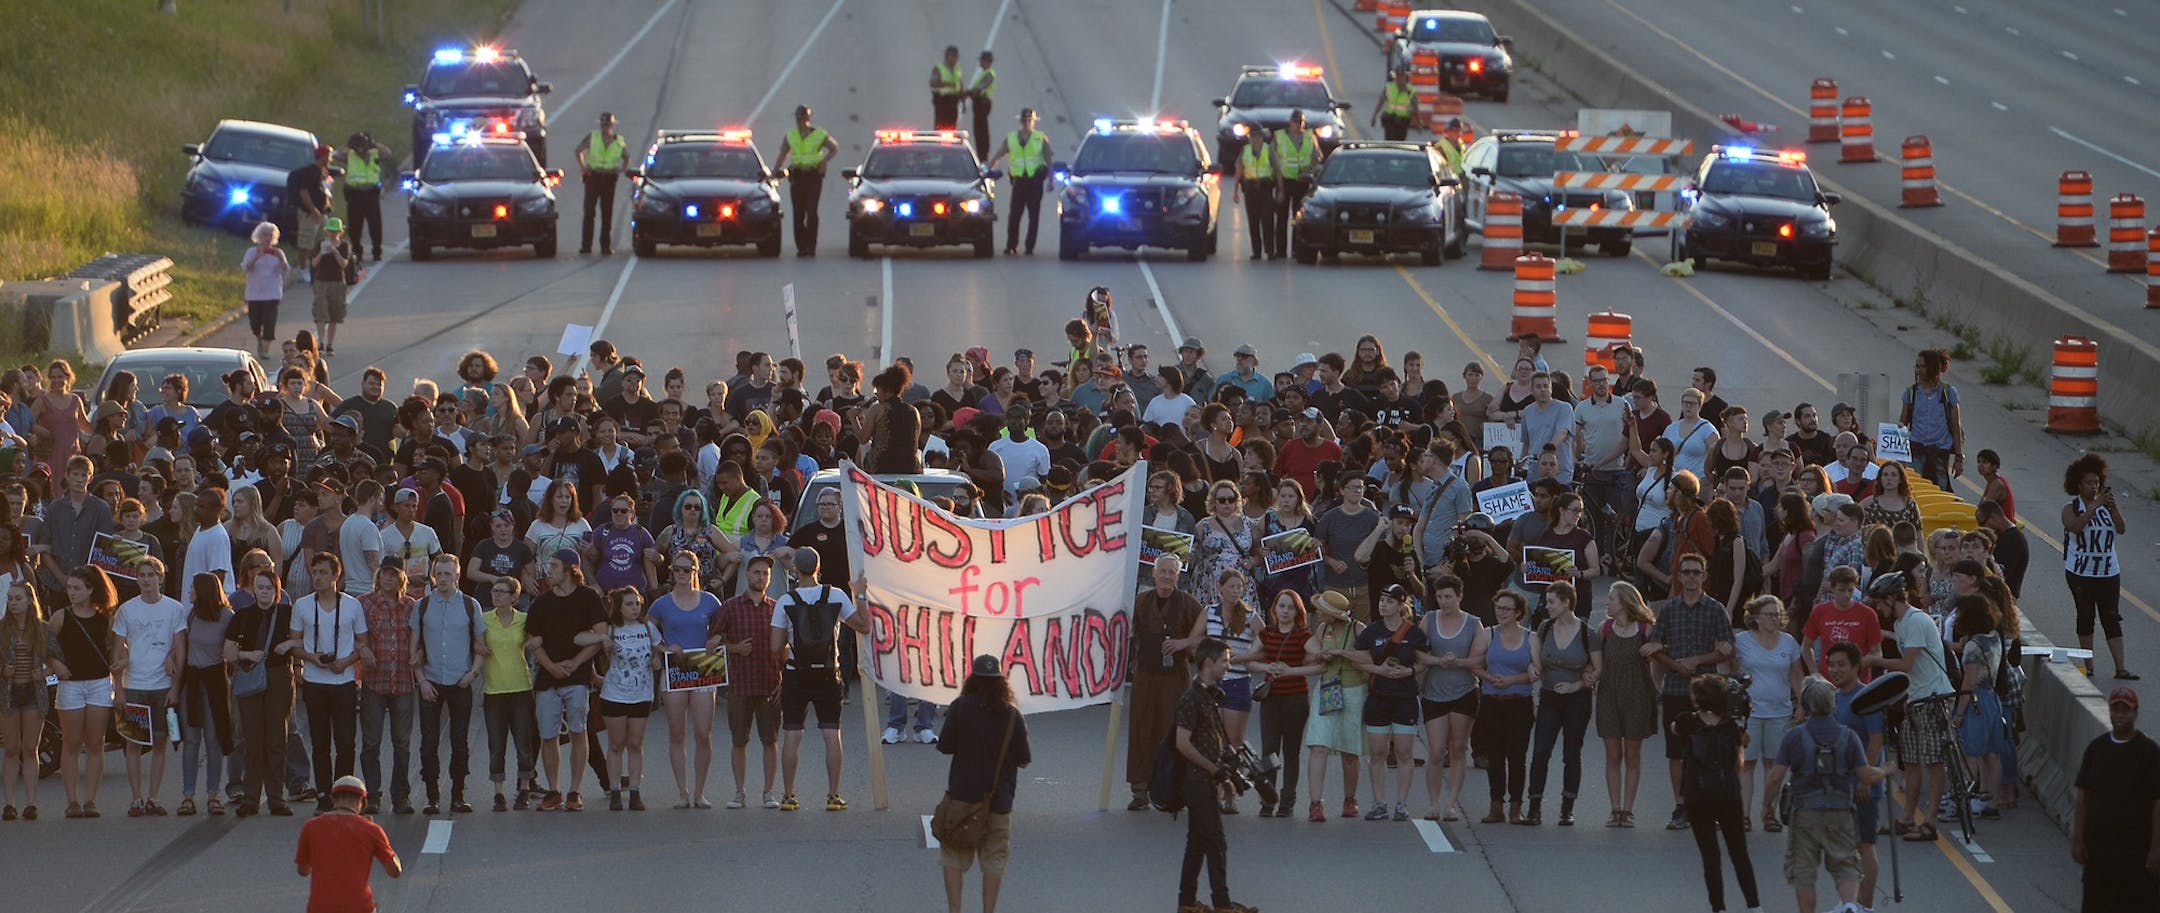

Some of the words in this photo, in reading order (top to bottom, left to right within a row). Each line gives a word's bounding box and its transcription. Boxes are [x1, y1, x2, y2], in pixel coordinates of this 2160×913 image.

[1483, 493, 1528, 516] SHAME
[2076, 530, 2114, 553] AKA
[1268, 551, 1294, 565] STAND
[2074, 553, 2112, 576] WTF
[1528, 565, 1552, 575] STAND
[948, 565, 1041, 617] for
[670, 671, 699, 681] STAND
[671, 676, 722, 689] TOGETHER
